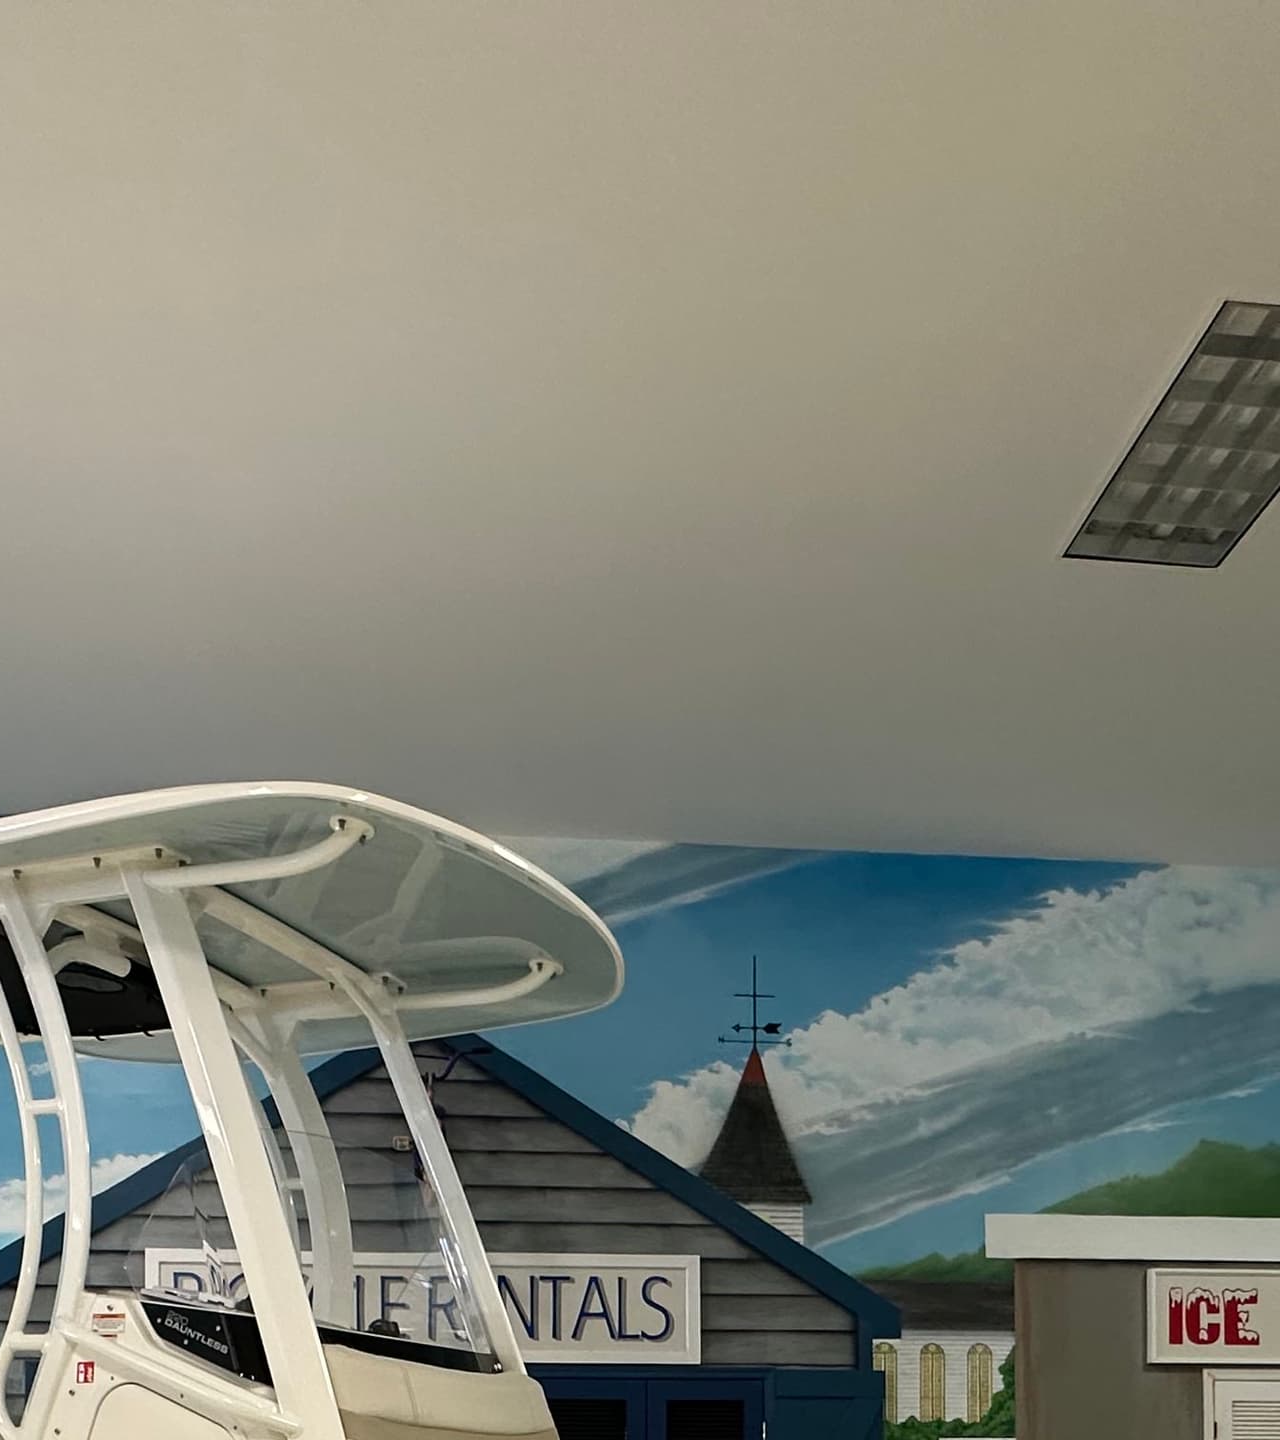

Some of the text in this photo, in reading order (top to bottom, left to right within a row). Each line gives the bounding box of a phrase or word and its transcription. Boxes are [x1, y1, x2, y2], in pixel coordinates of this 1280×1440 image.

[164, 1318, 229, 1354] DAUNTLESS
[427, 1274, 674, 1342] RNTALS
[1169, 1287, 1260, 1345] ICE
